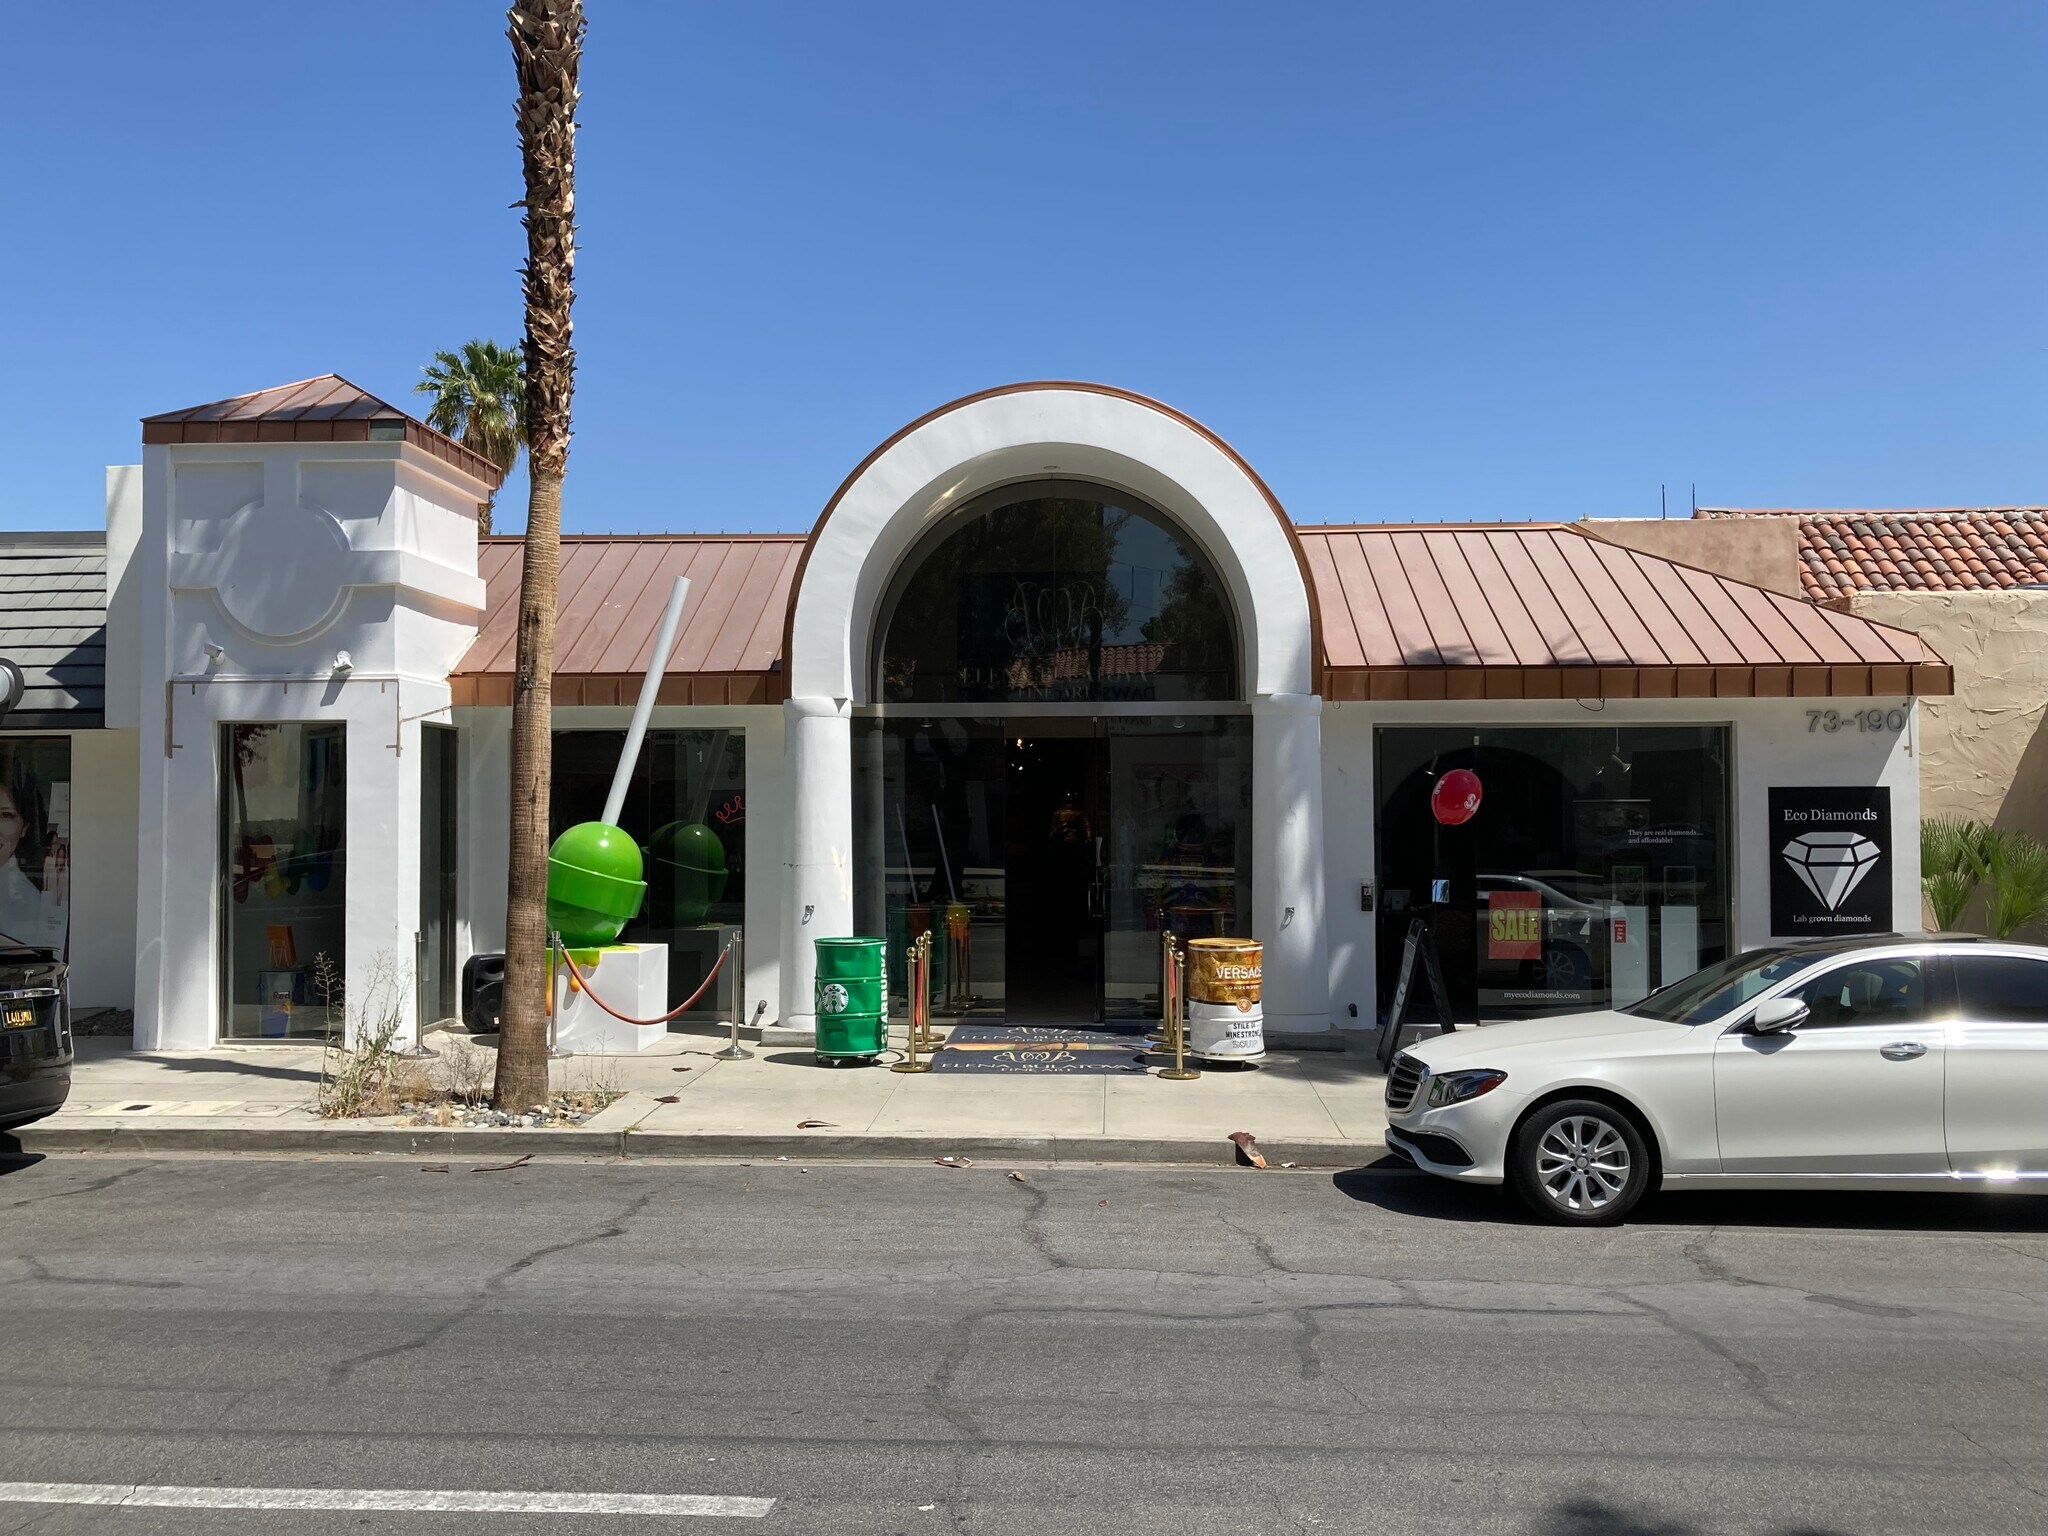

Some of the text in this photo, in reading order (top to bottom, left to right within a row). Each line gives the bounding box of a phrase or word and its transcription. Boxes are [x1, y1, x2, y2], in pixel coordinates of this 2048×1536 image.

[1806, 709, 1906, 733] 73-190
[1783, 808, 1878, 821] Eco Diamonds
[1628, 829, 1643, 837] They
[1793, 914, 1872, 924] Lab grown diamonds
[1491, 908, 1539, 942] SALE
[1216, 965, 1262, 979] VERSACE
[273, 991, 290, 1000] Red
[1503, 990, 1581, 1000] myecodiamonds.com
